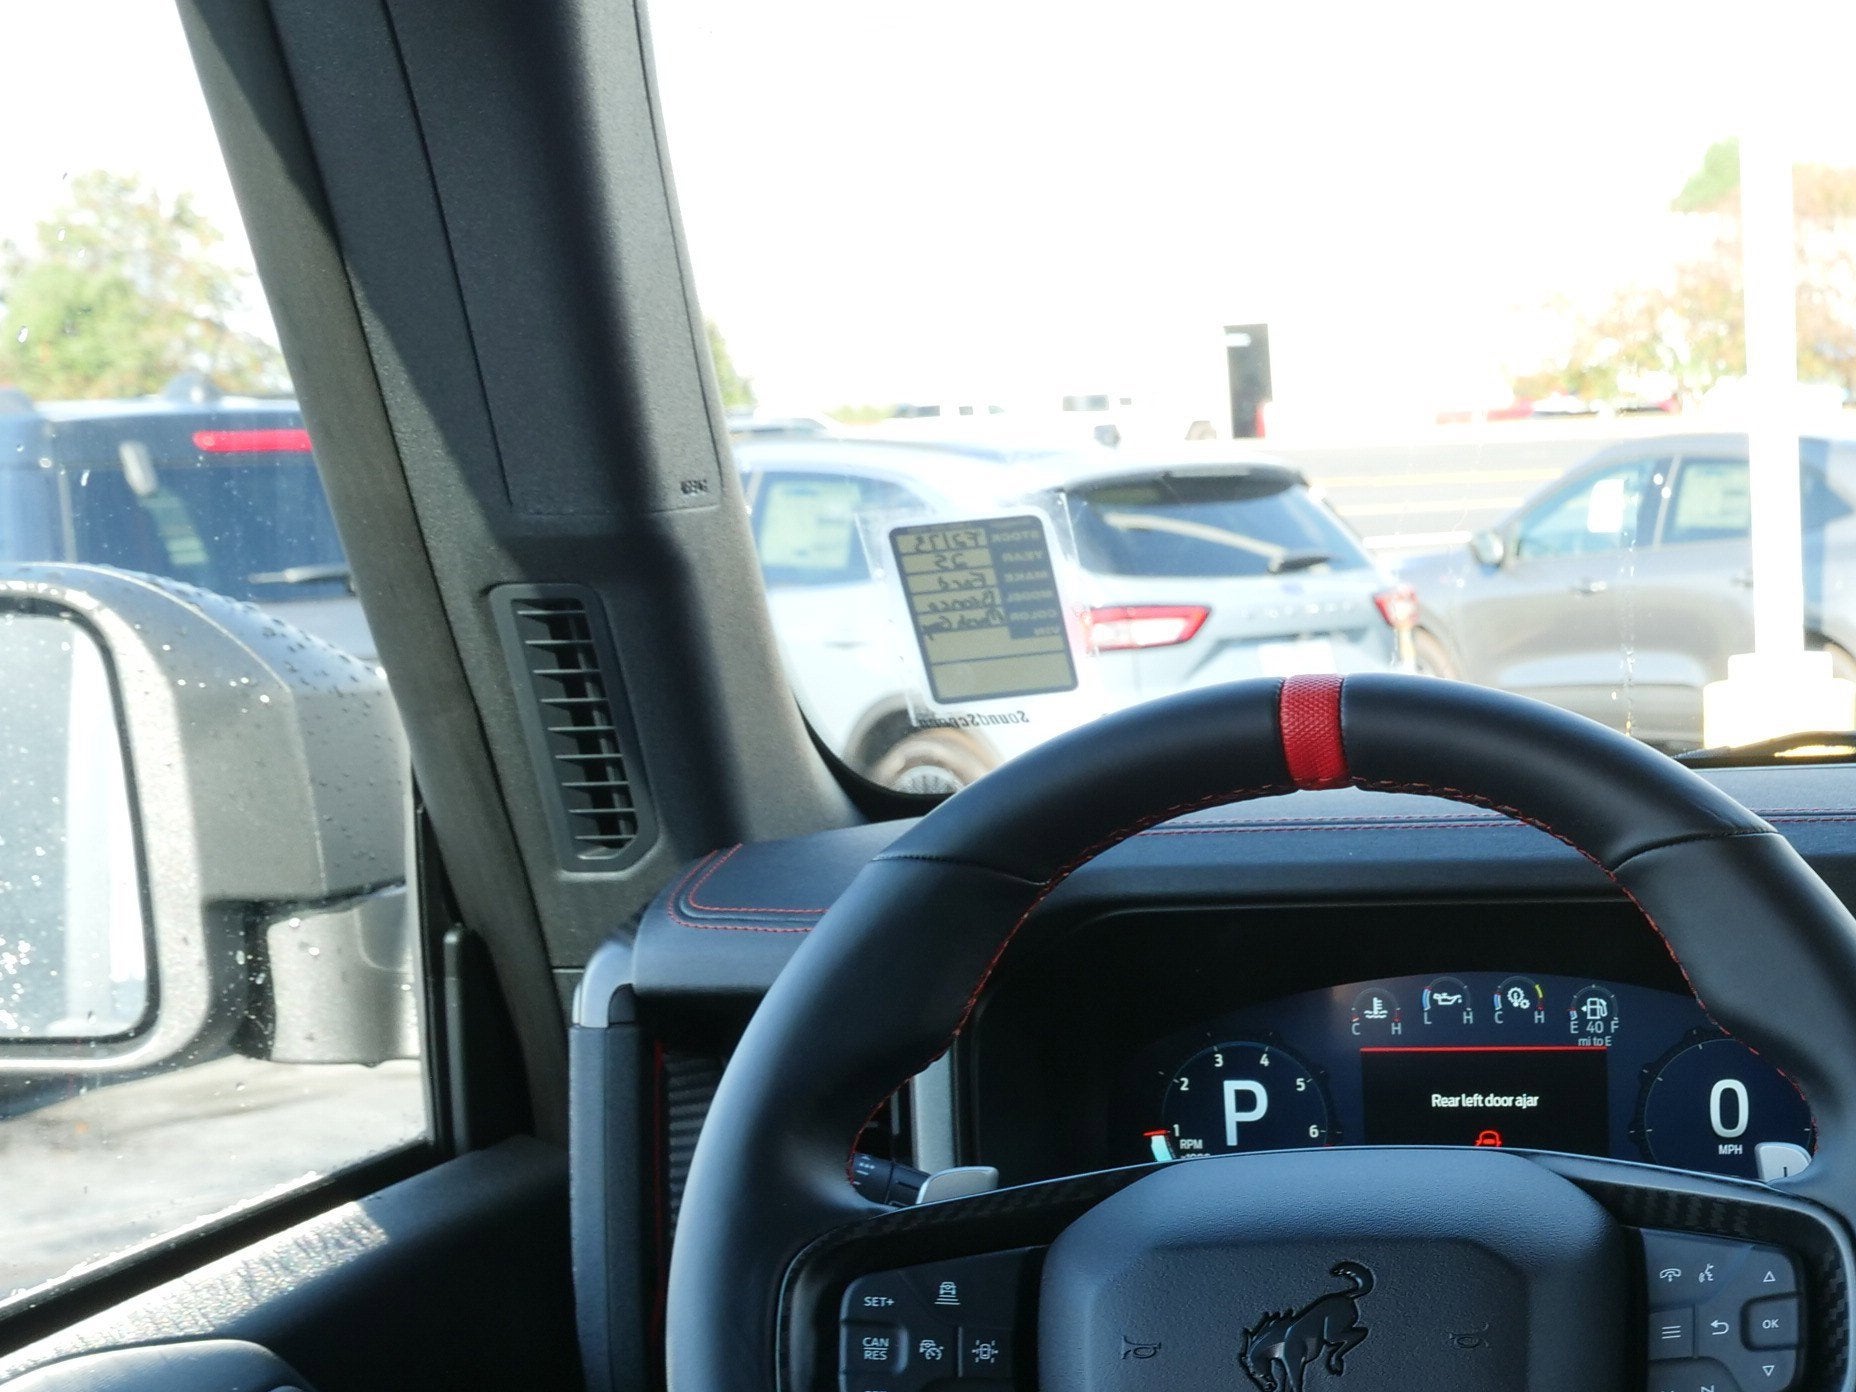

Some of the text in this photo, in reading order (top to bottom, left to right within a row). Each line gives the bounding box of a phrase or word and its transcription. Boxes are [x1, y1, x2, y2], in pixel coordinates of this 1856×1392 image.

[1424, 1012, 1432, 1025] L
[1463, 1011, 1473, 1024] H
[1494, 1012, 1503, 1024] C
[1535, 1011, 1545, 1023] H
[1352, 1023, 1361, 1035] C
[1391, 1022, 1401, 1035] H
[1570, 1021, 1579, 1034] E
[1586, 1021, 1604, 1034] 40
[1611, 1021, 1619, 1033] F
[1578, 1036, 1612, 1047] mi to E
[1214, 1053, 1224, 1067] 3
[1259, 1053, 1270, 1067] 4
[1180, 1077, 1190, 1091] 2
[1296, 1077, 1306, 1092] 5
[1431, 1093, 1539, 1109] Rear left door ajar
[1223, 1080, 1268, 1146] P
[1709, 1078, 1749, 1138] 0
[1173, 1124, 1180, 1137] 1
[1309, 1125, 1319, 1138] 6
[1180, 1139, 1203, 1149] RPM
[1718, 1144, 1743, 1155] MPH
[863, 1296, 895, 1307] SET+
[1762, 1319, 1779, 1329] OK
[862, 1337, 889, 1347] CAN
[864, 1351, 888, 1361] RES
